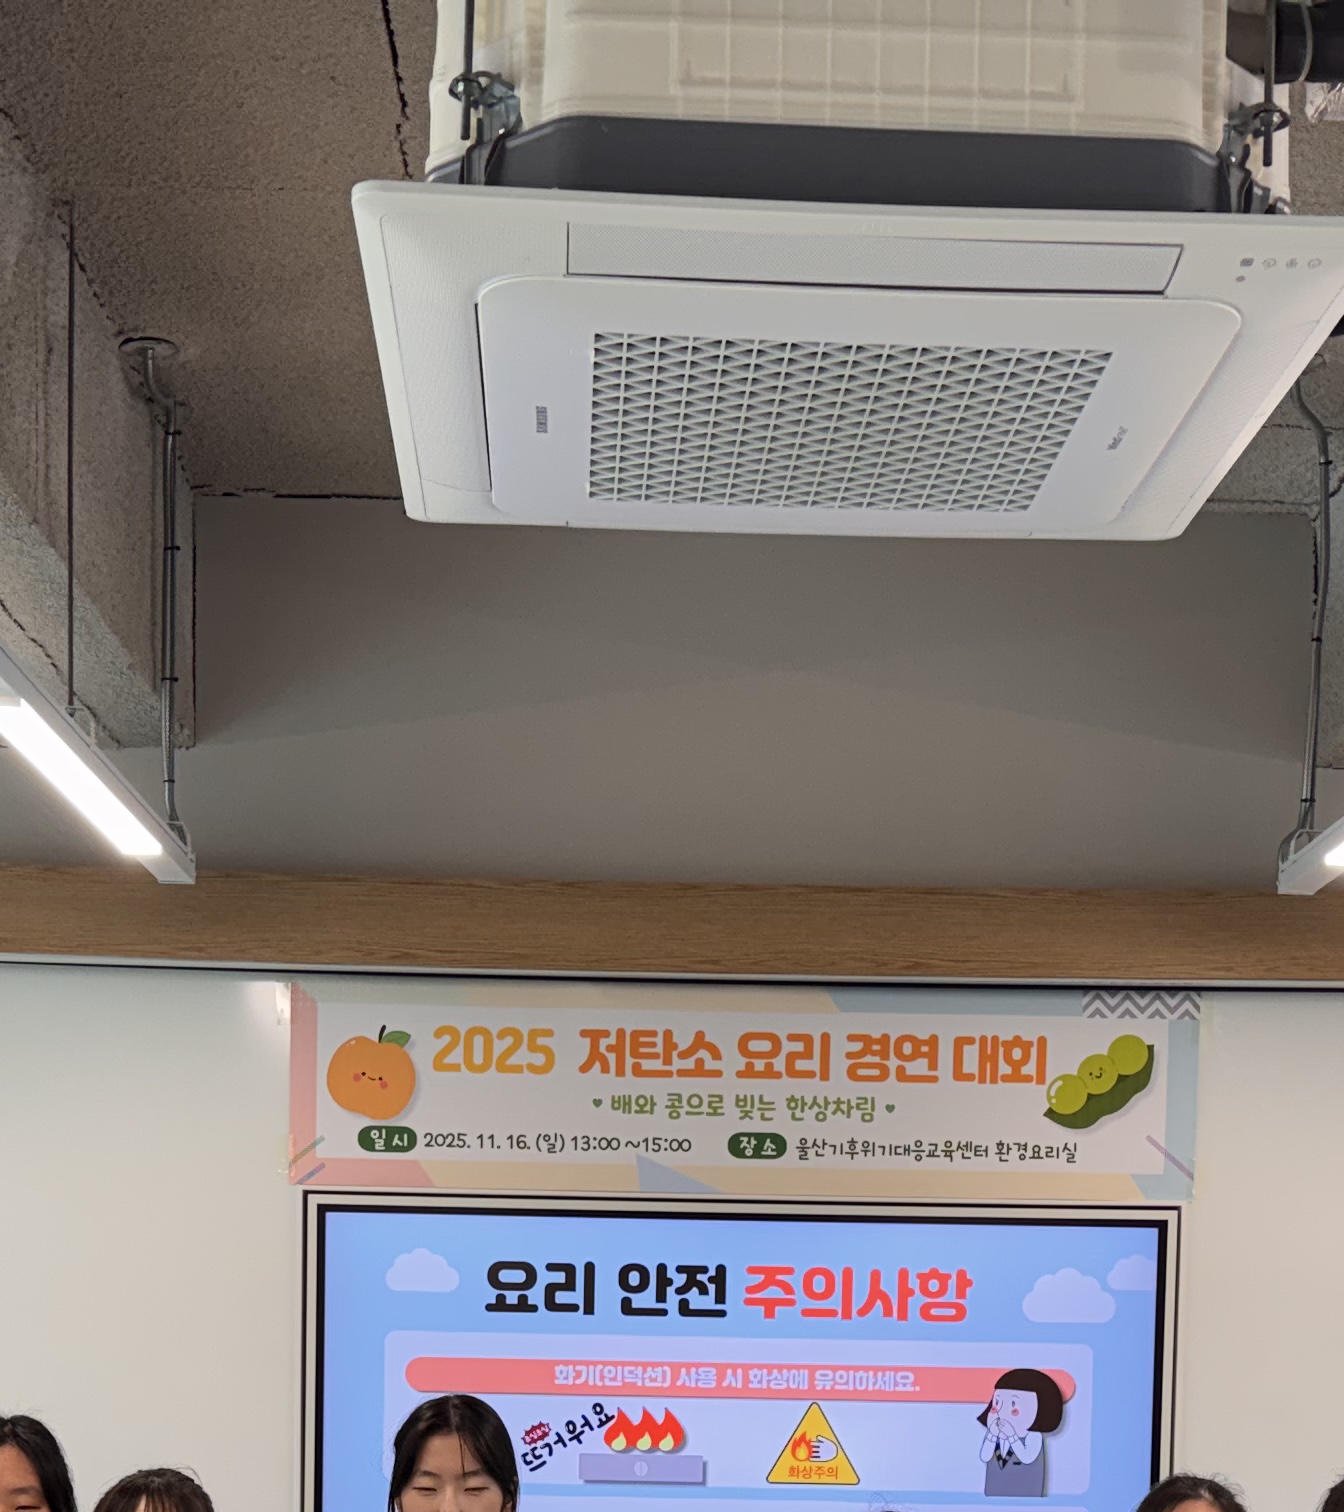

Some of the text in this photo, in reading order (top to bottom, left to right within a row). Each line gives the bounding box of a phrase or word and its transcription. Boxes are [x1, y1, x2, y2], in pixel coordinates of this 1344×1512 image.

[432, 1025, 1047, 1085] 2025 저탄소 요리 경연 대회
[611, 1093, 876, 1123] 배와 콩으로 빚는 한상차림
[423, 1133, 471, 1148] 2025.
[479, 1134, 501, 1149] 11.
[507, 1135, 531, 1150] 16.
[536, 1132, 565, 1154] (일)
[570, 1135, 621, 1151] 13:00
[796, 1137, 1077, 1164] 울산기후위기대응교육센터 환경요리실
[484, 1261, 973, 1323] 요리 안전 주의사항
[554, 1363, 921, 1392] 화기(인덕션) 사용 시 화상에 유의하세요.
[521, 1402, 615, 1472] 뜨거워요
[788, 1464, 839, 1481] 화상주의
